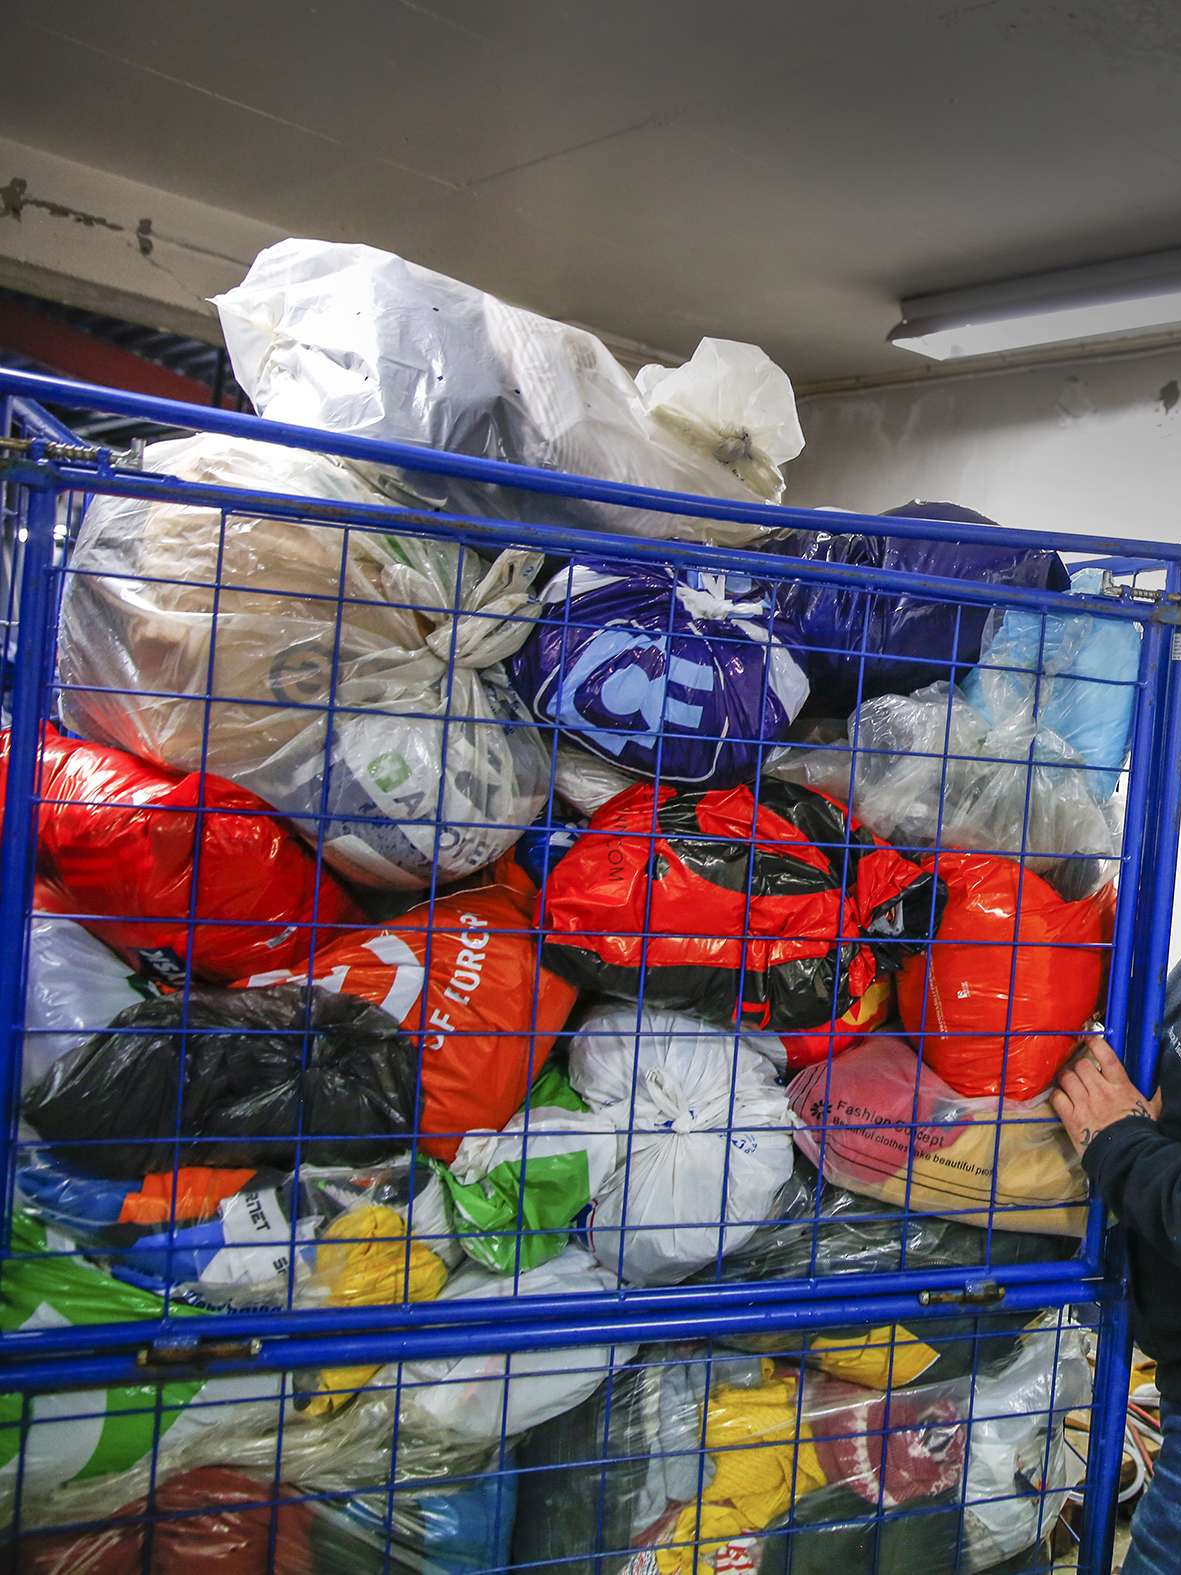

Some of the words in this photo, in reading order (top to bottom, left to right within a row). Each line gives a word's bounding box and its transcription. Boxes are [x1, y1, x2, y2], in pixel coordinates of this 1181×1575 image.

[443, 909, 489, 1006] EUROP
[837, 1099, 891, 1127] Fashion
[932, 1154, 975, 1174] beautiful
